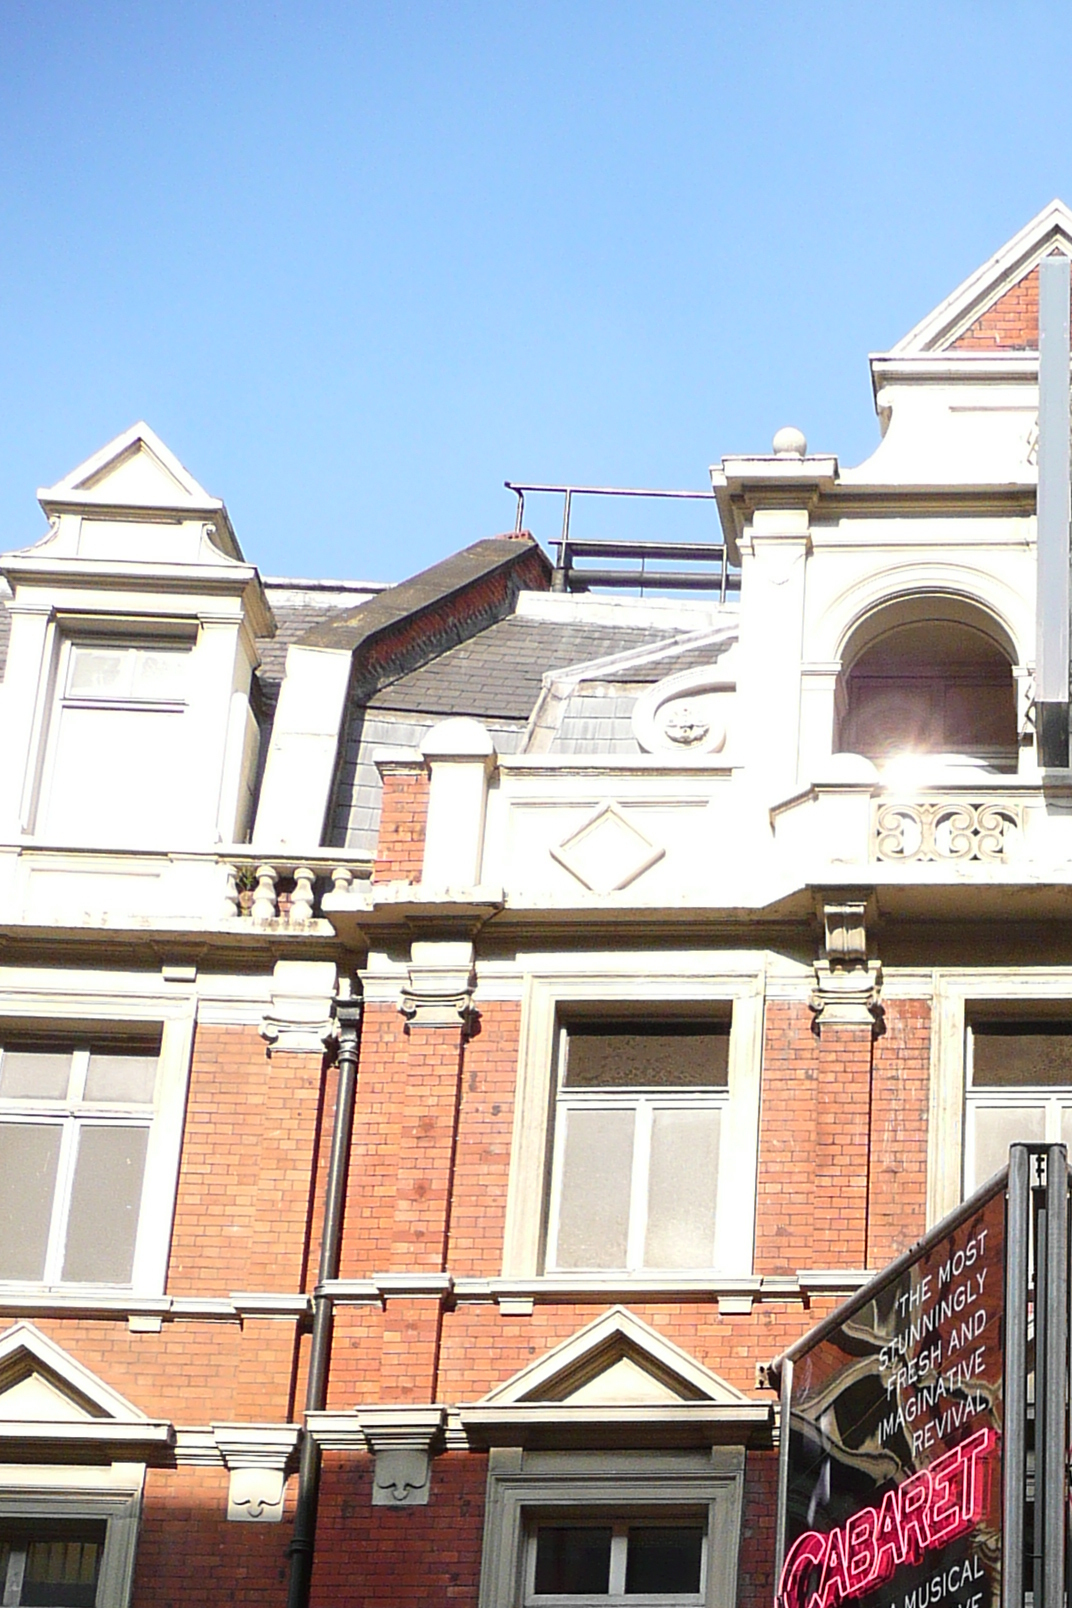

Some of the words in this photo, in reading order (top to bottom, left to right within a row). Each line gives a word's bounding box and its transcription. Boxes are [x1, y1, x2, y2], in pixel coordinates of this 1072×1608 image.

[938, 1229, 988, 1289] MOST
[878, 1267, 988, 1372] STUNNINGLY
[886, 1339, 942, 1401] FRESH
[946, 1308, 988, 1357] AND
[877, 1345, 986, 1446] IMAGINATIVE
[911, 1388, 987, 1458] REVIVAL
